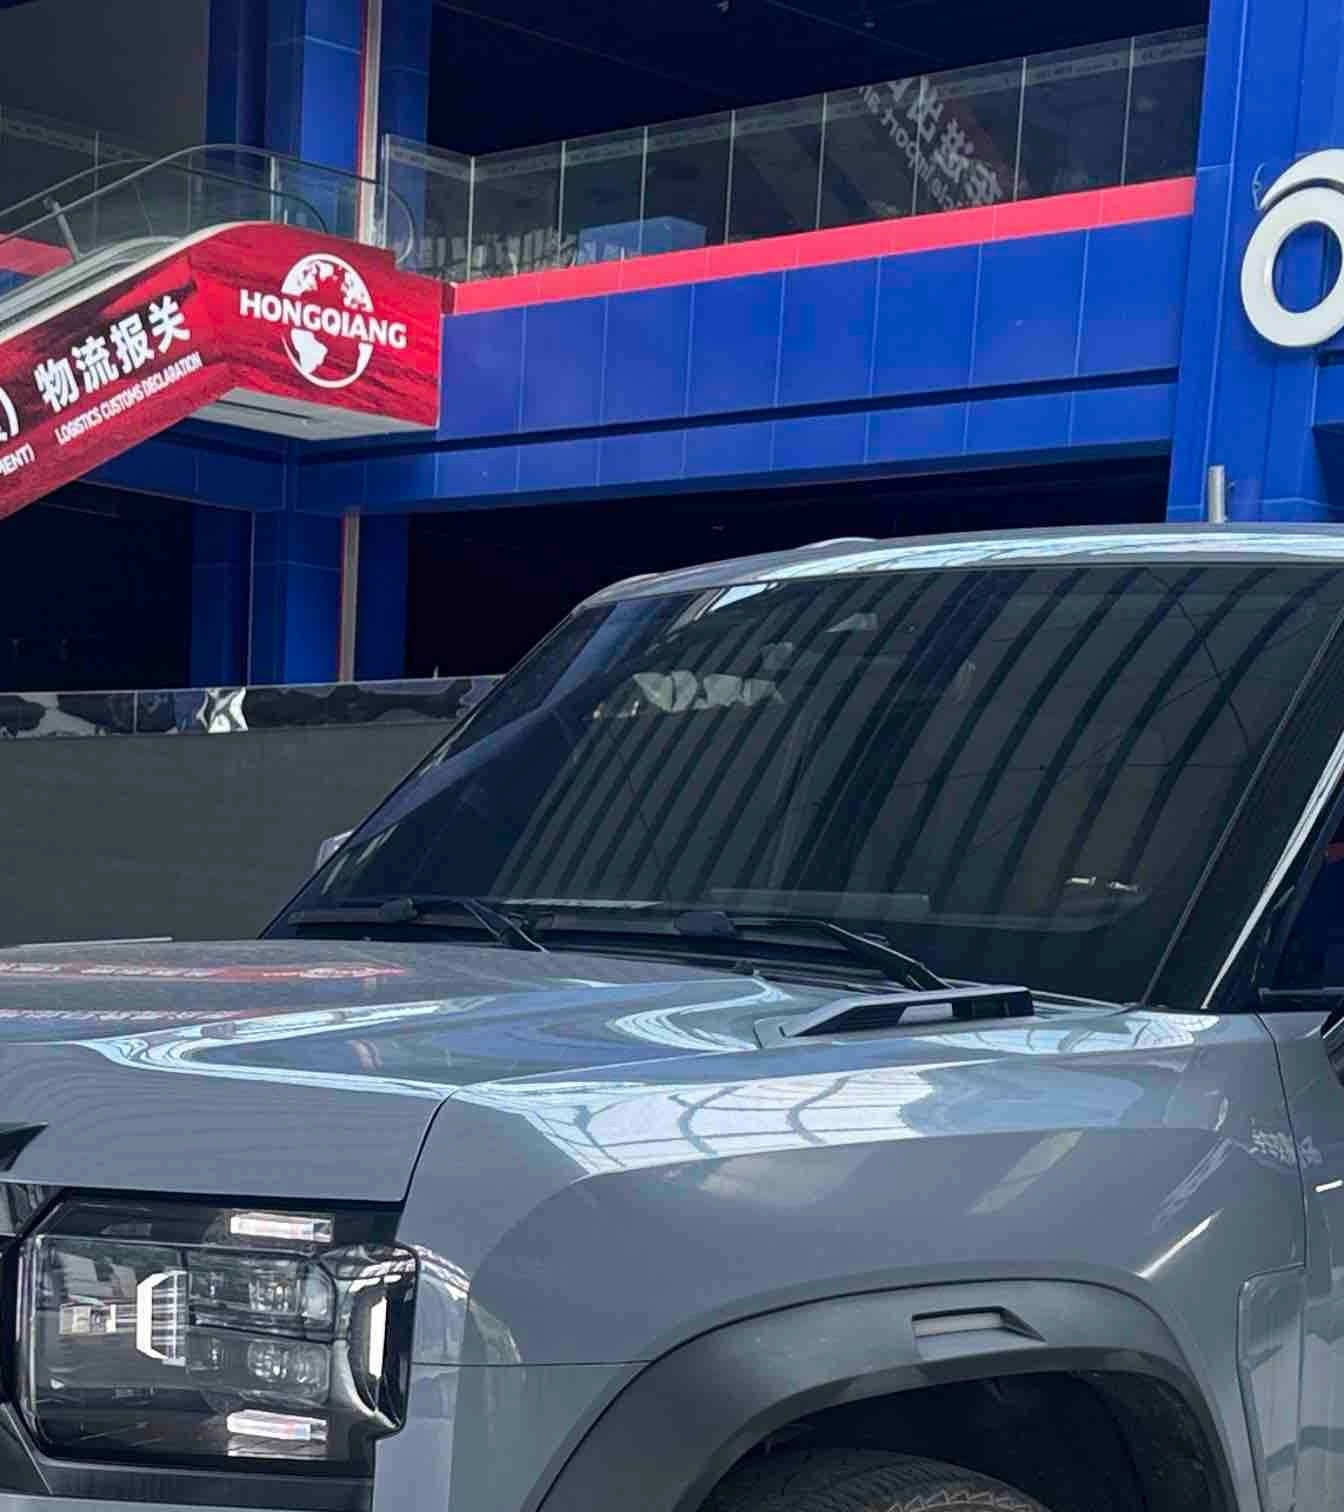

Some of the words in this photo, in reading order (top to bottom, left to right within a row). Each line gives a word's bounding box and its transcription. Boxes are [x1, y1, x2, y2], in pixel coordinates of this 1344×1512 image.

[34, 295, 191, 413] 物流报关
[239, 288, 408, 350] HONGQIANG
[54, 406, 103, 445] LOGISTICS
[99, 384, 145, 419] CUSTOMS
[141, 351, 204, 398] DECLARATION
